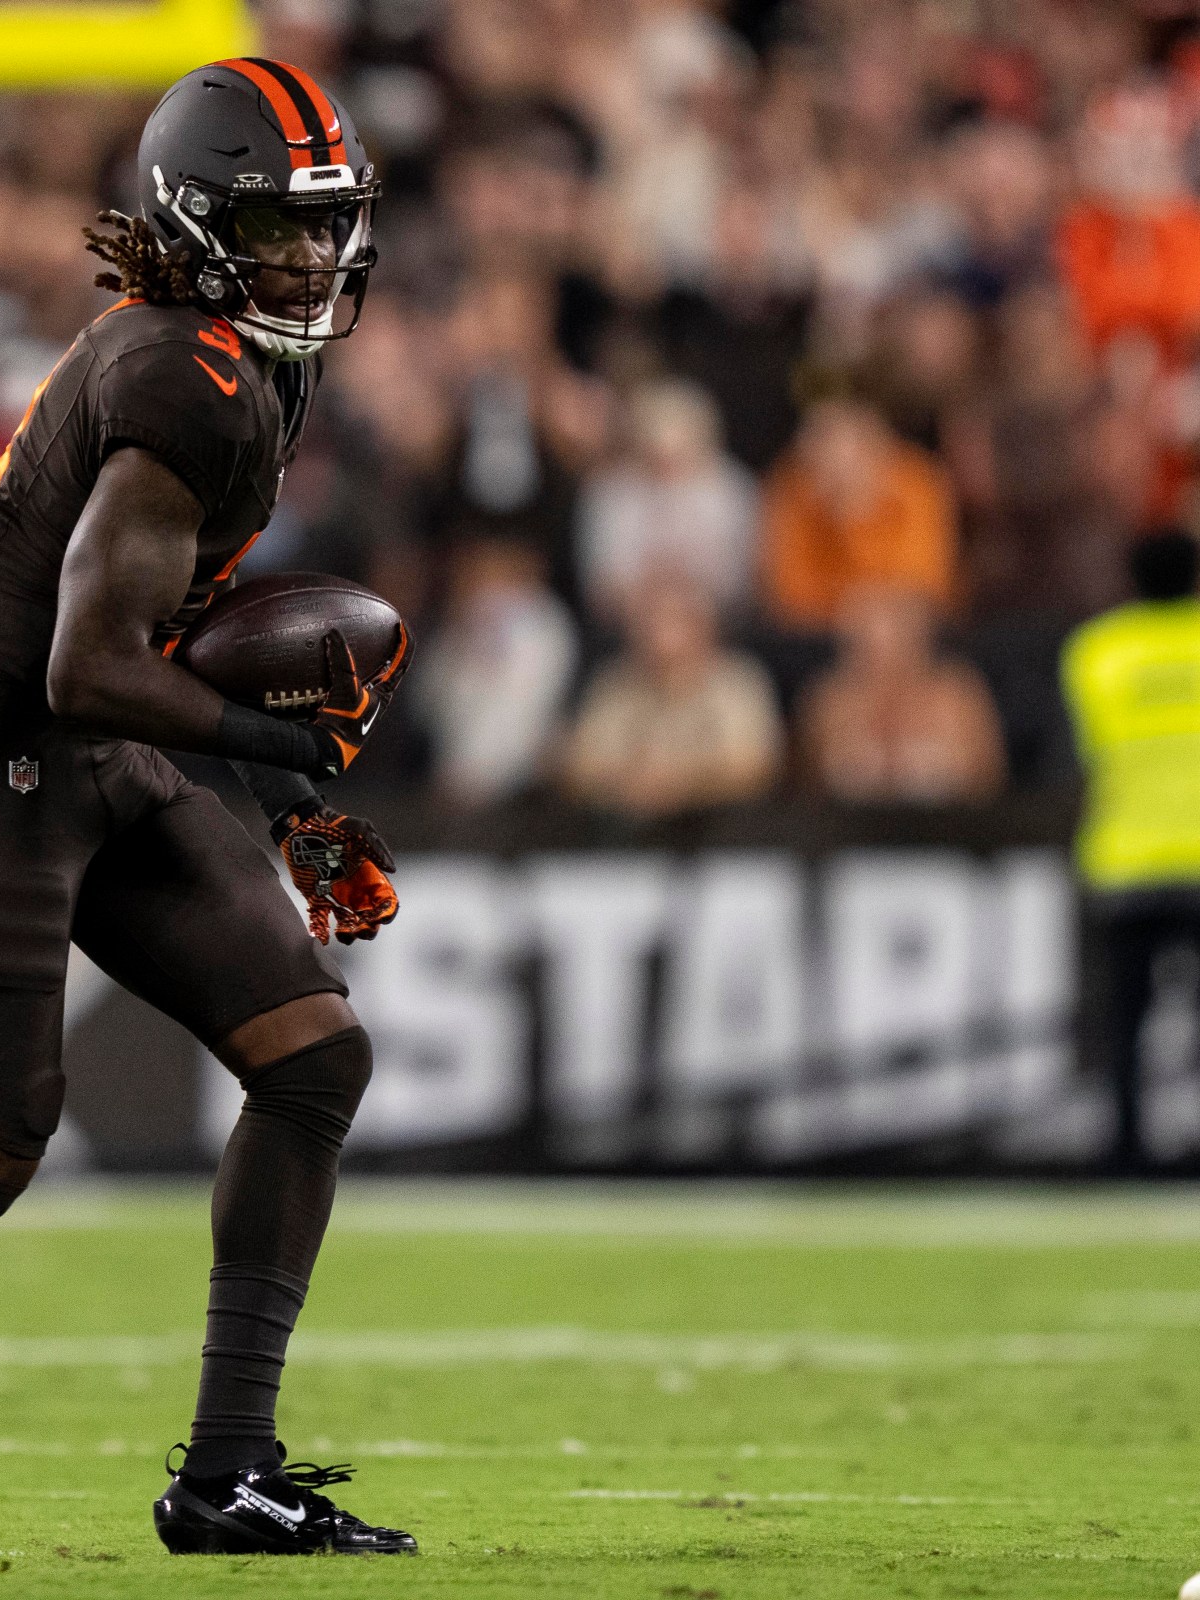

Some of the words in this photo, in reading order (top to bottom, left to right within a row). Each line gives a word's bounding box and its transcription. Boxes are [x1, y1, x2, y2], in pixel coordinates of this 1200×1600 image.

[310, 169, 341, 180] BROWNS
[14, 772, 36, 786] NFL
[233, 1486, 271, 1514] AIR
[269, 1511, 298, 1532] ZOOM
